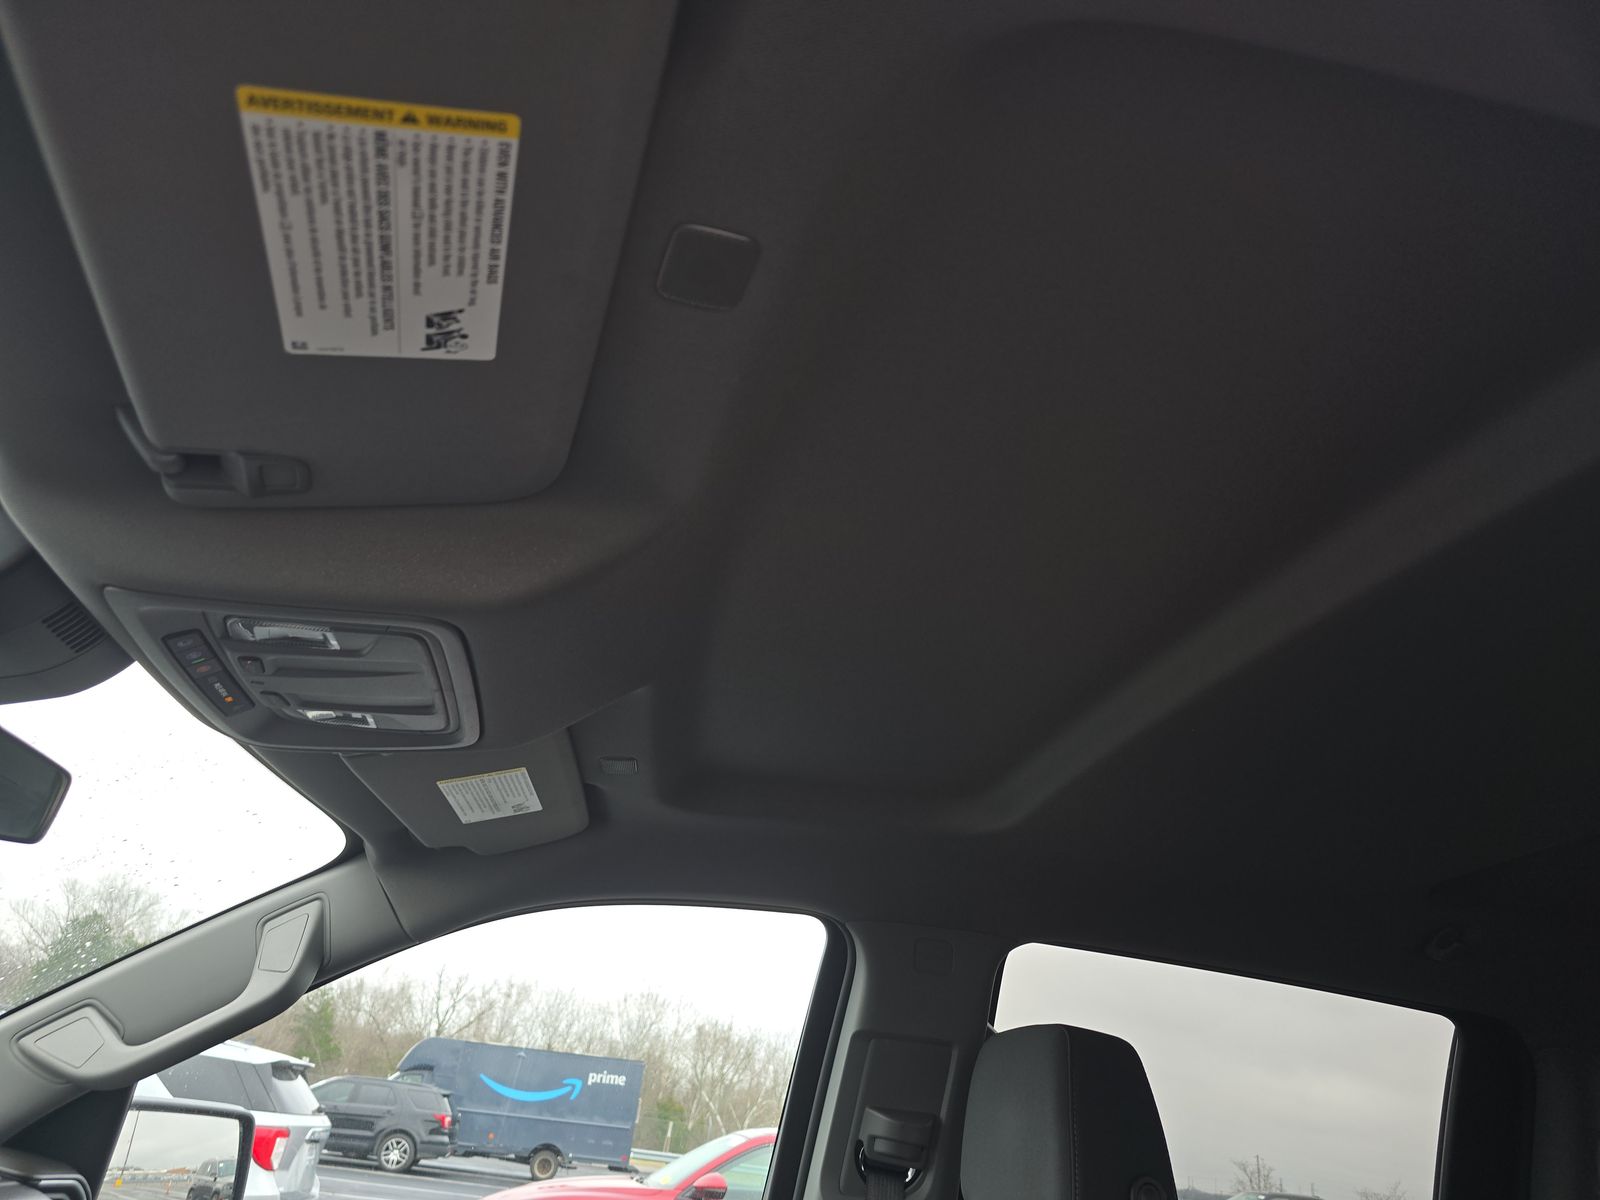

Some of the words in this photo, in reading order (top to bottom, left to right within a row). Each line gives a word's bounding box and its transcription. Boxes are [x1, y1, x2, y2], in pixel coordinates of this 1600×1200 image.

[246, 94, 394, 122] AVERTISSEMENT
[425, 112, 508, 133] WARNING
[496, 141, 511, 167] EVEN
[494, 171, 508, 193] WITH
[490, 198, 505, 244] ADVANCED
[488, 247, 501, 260] AIR
[486, 263, 499, 284] BAGS
[588, 1070, 626, 1086] prime
